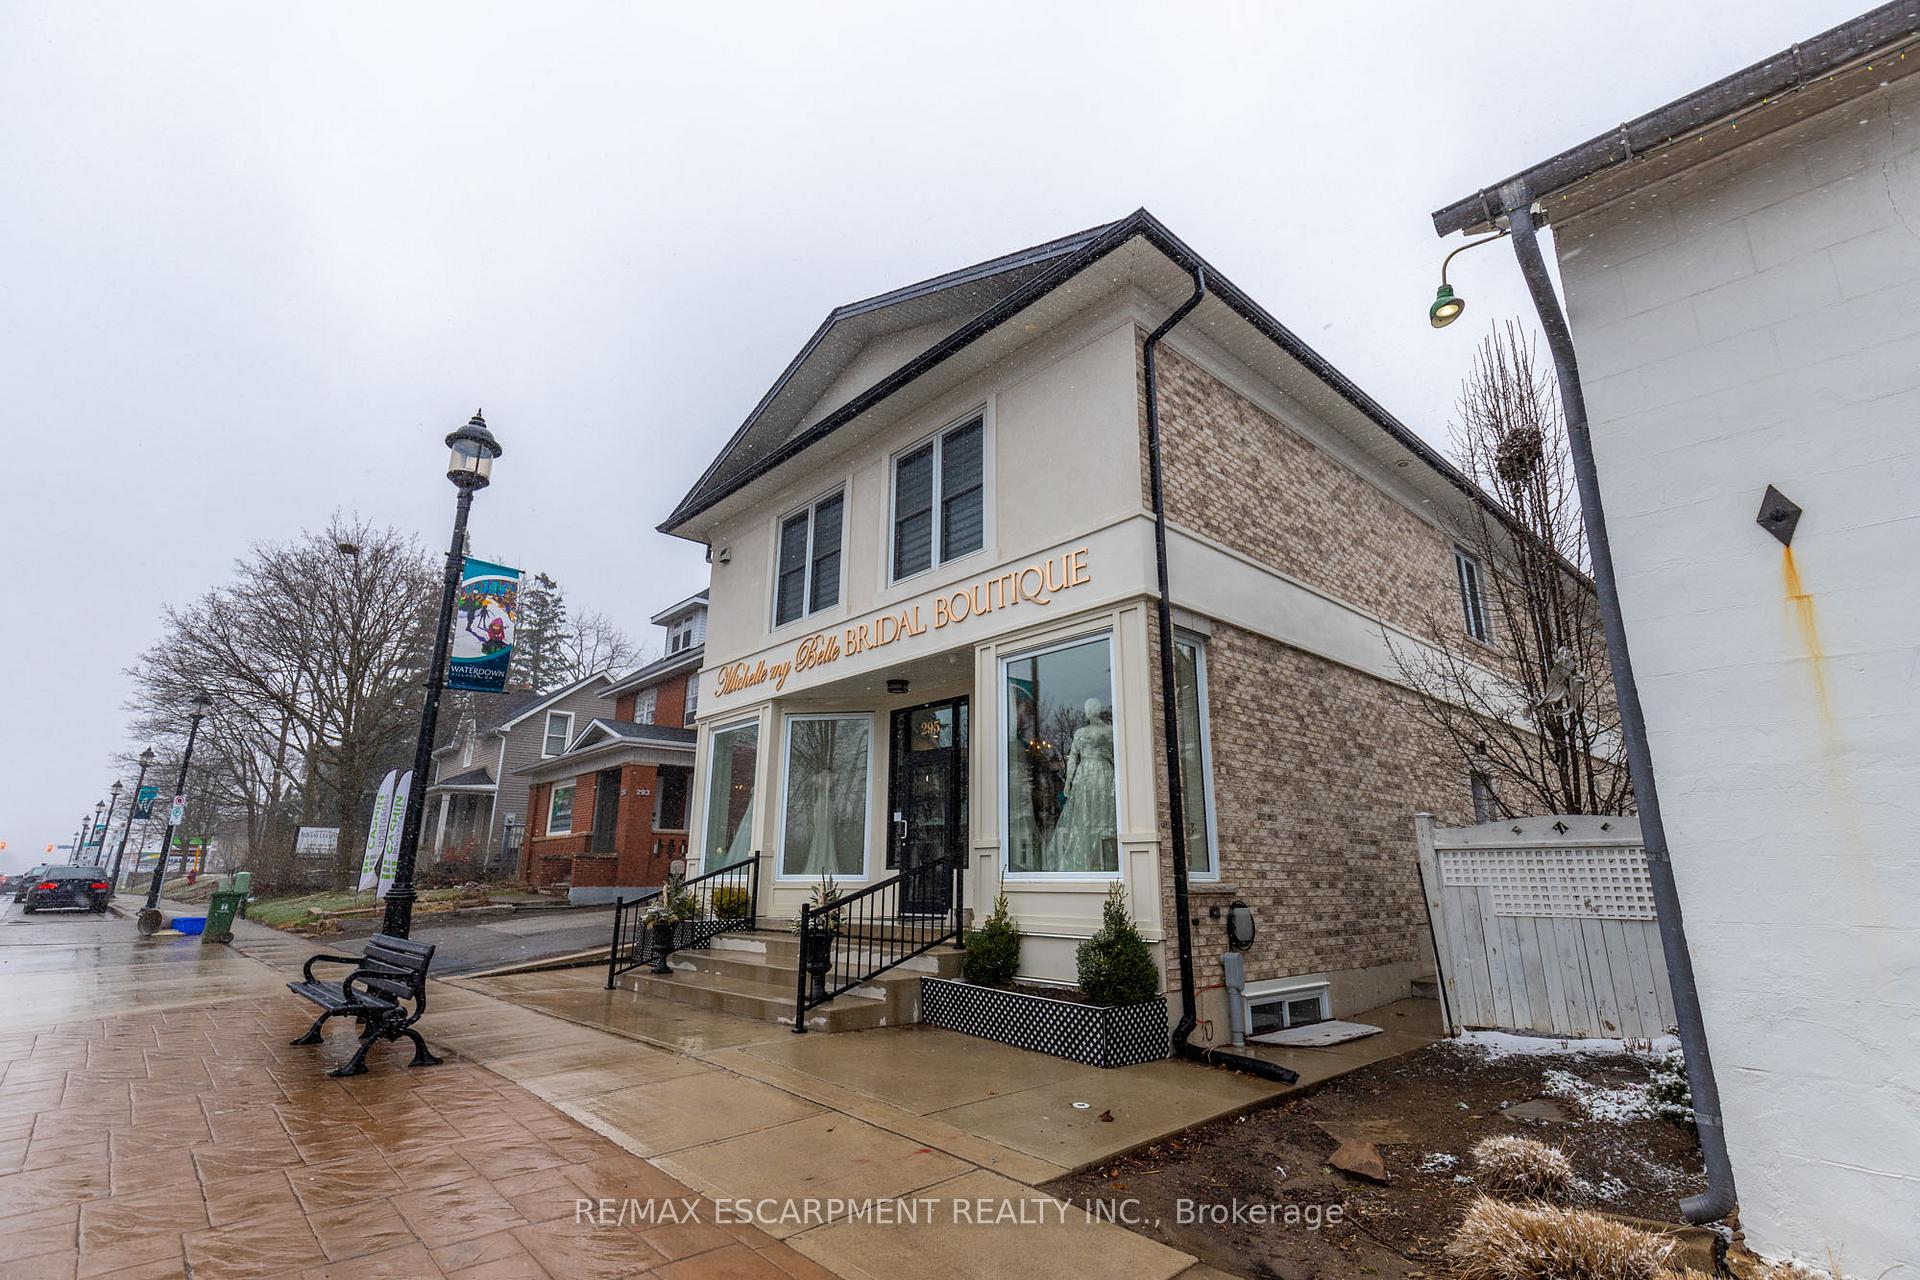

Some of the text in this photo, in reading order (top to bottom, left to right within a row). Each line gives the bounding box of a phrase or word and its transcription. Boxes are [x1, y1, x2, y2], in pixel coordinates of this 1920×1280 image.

[715, 547, 1091, 697] Michelle my Belle BRIDAL BOUTIQUE
[451, 665, 505, 678] WATERDOWN
[920, 720, 941, 736] 295
[368, 794, 384, 850] CASHIN
[386, 795, 403, 855] CASHIN
